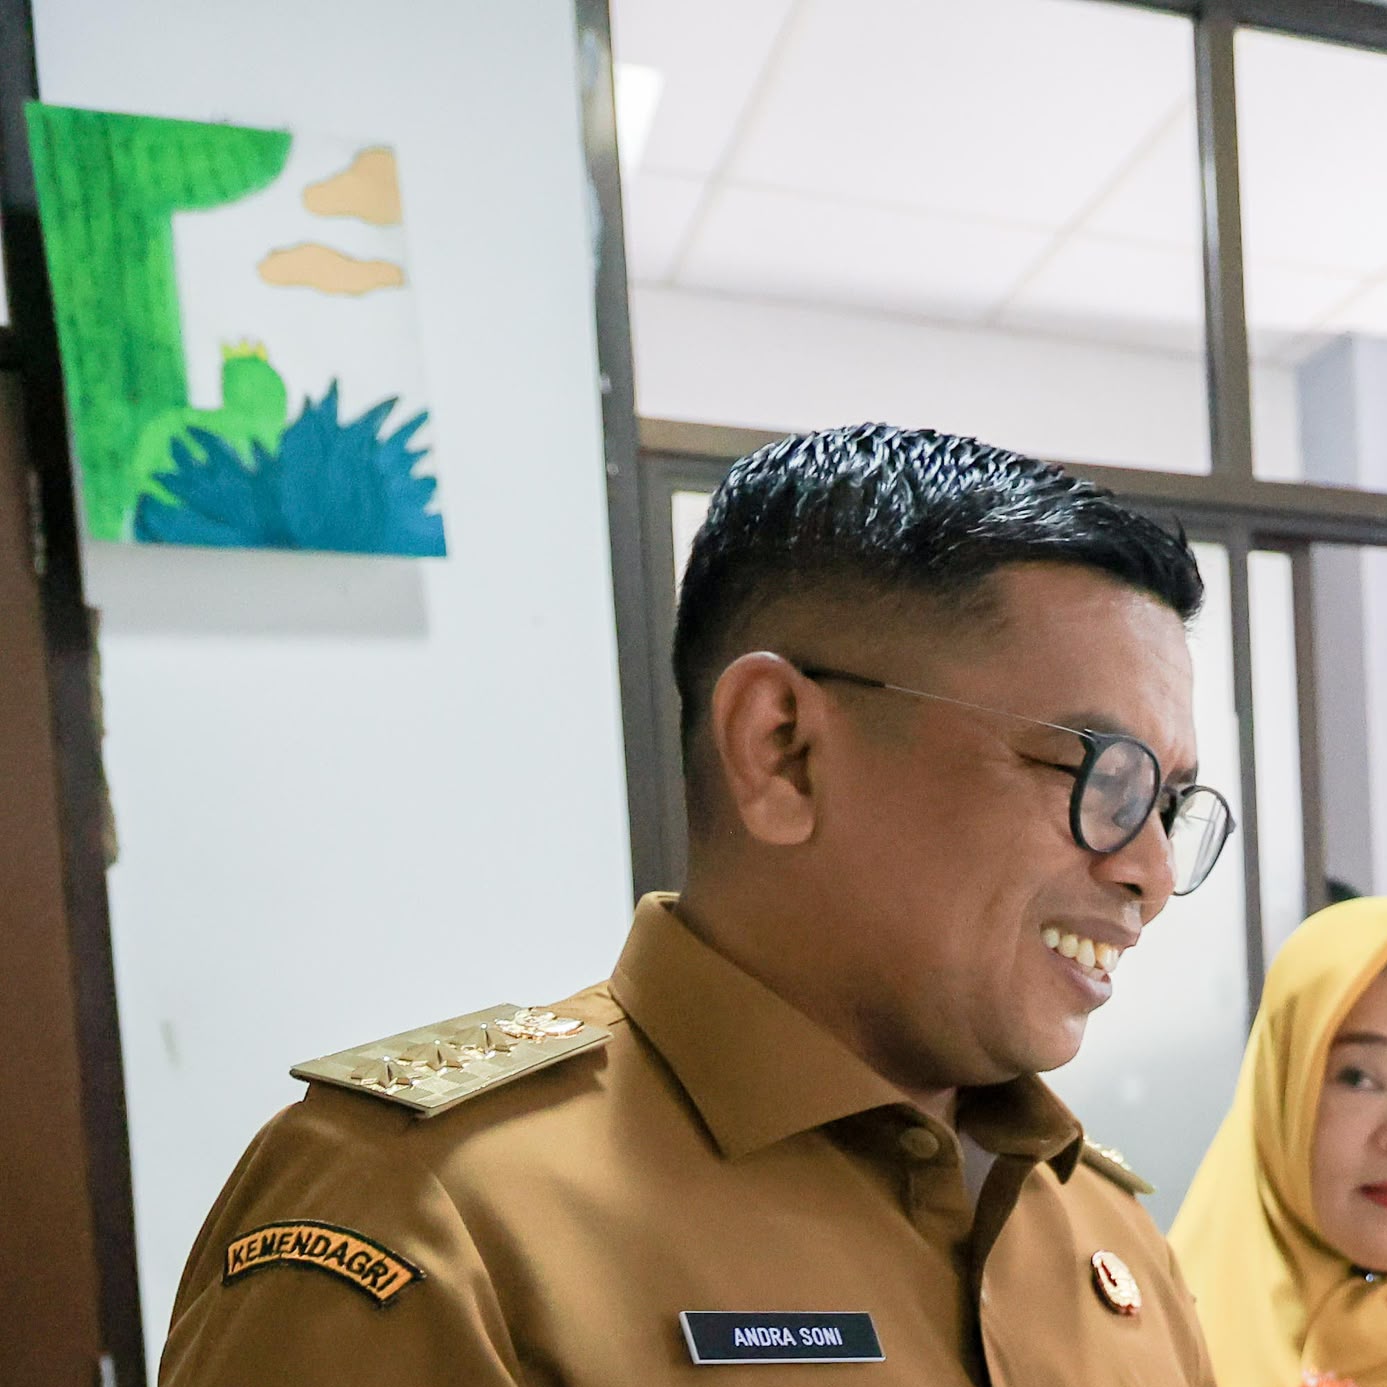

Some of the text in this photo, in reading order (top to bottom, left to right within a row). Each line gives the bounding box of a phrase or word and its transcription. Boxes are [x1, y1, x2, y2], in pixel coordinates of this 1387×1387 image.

[231, 1231, 399, 1293] KEMENDAGRI
[733, 1327, 843, 1347] ANDRA SONI
